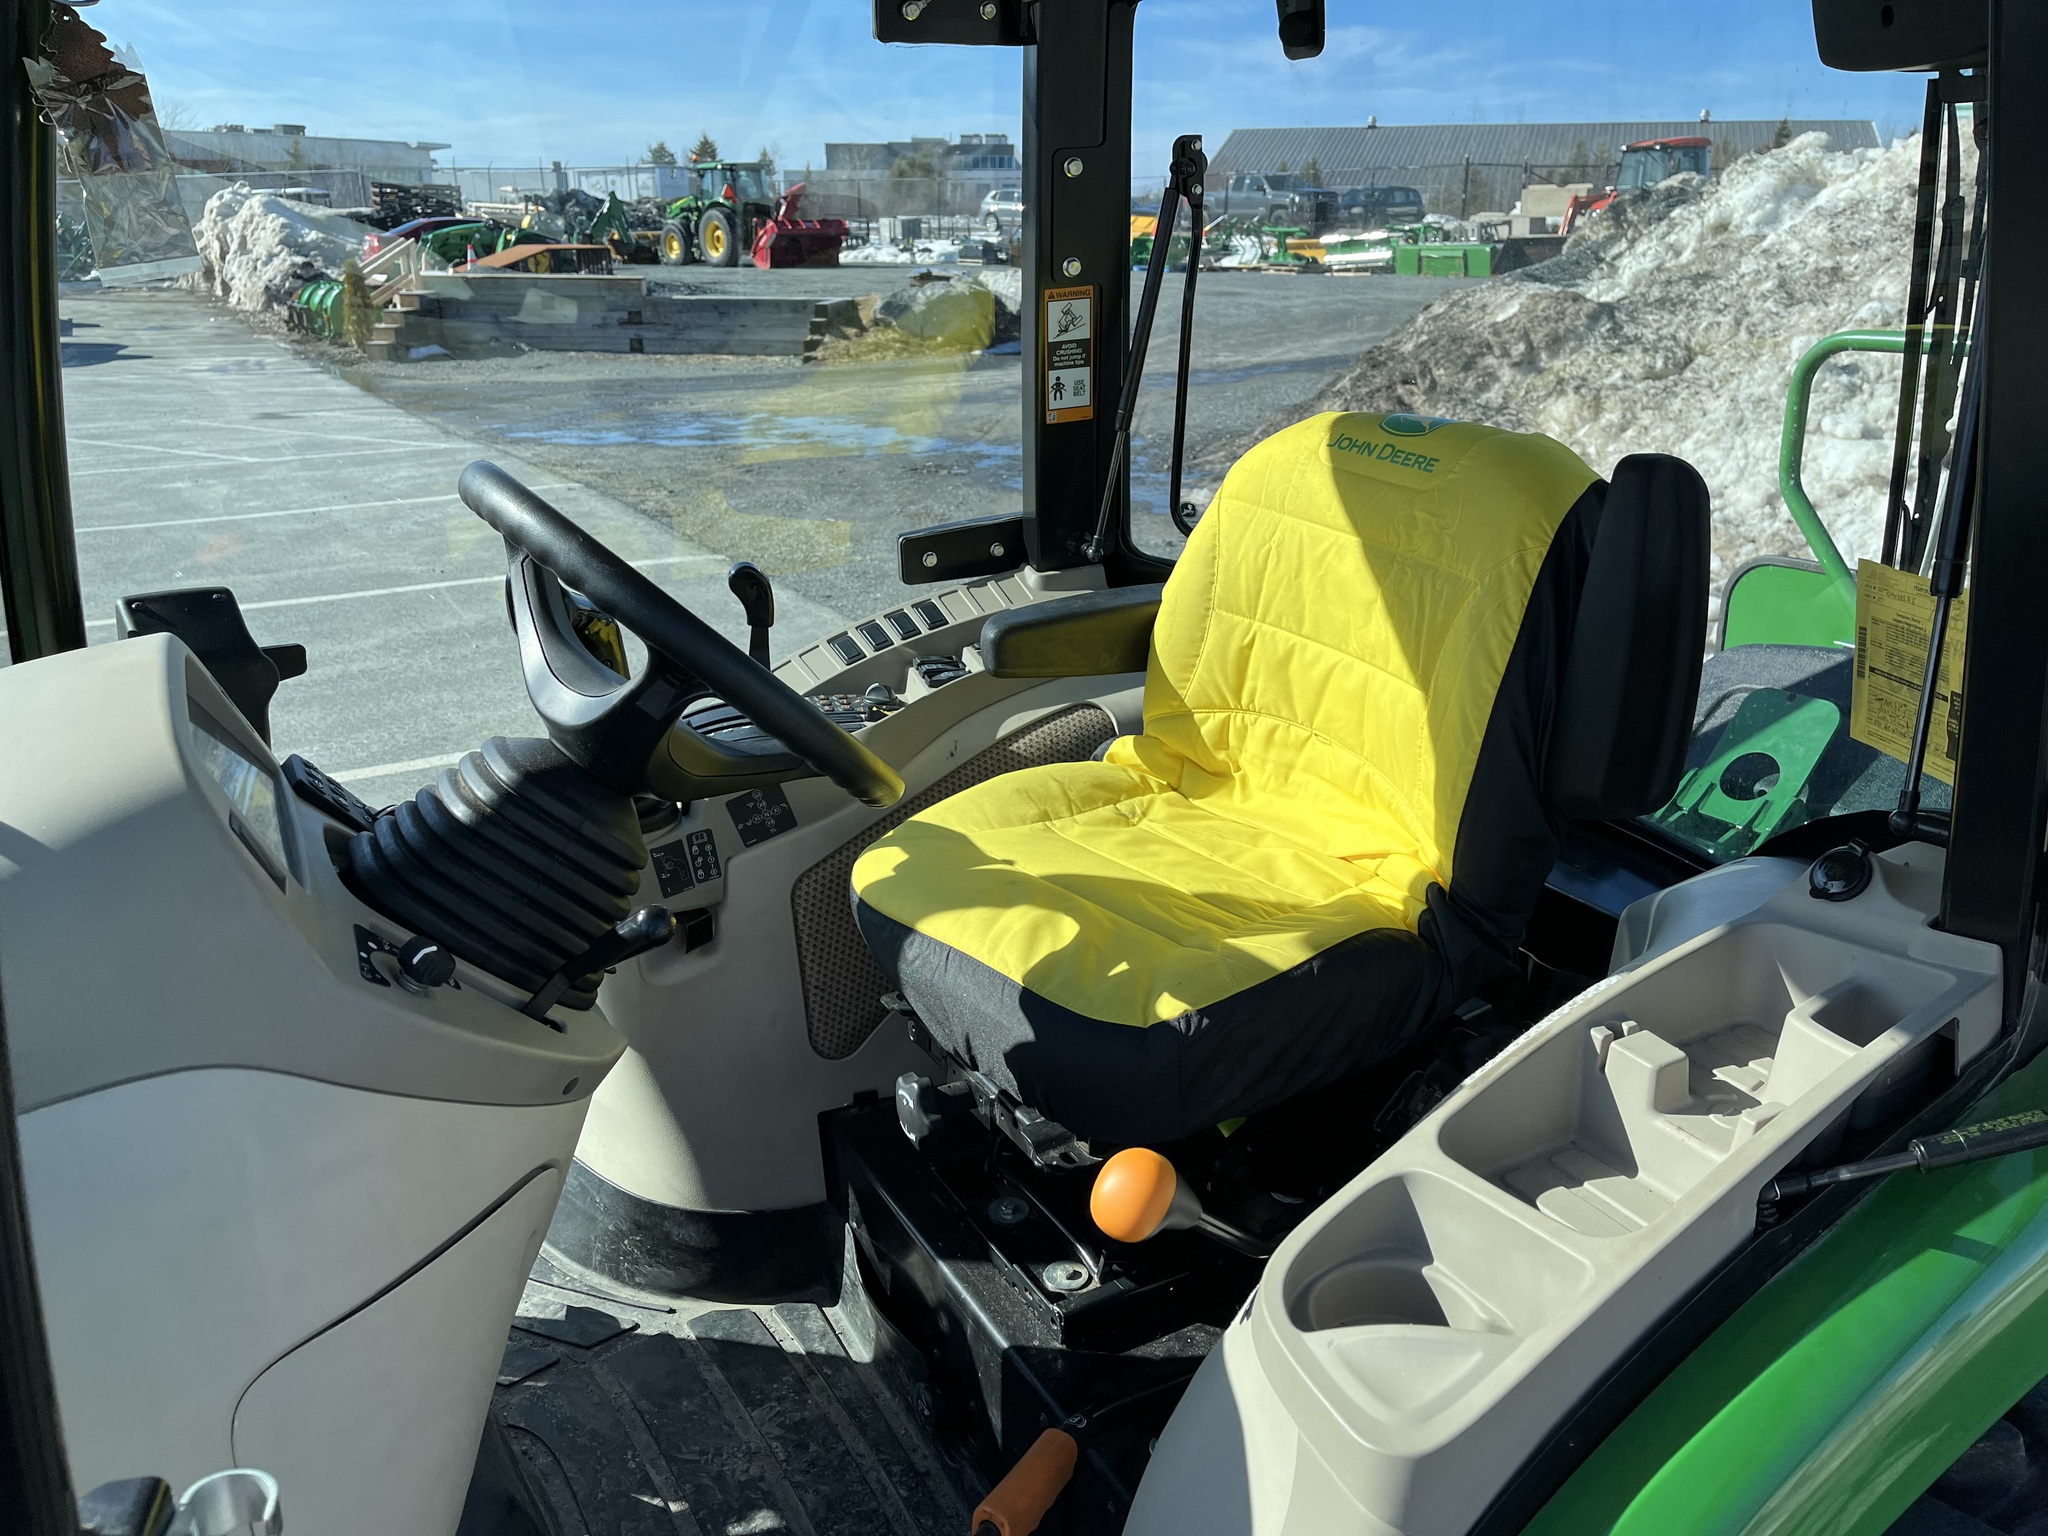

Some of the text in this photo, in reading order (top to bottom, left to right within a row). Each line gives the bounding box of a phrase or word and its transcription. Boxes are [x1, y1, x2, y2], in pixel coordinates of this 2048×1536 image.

[1055, 289, 1091, 298] WARNING
[1326, 433, 1440, 473] JOHN DEERE
